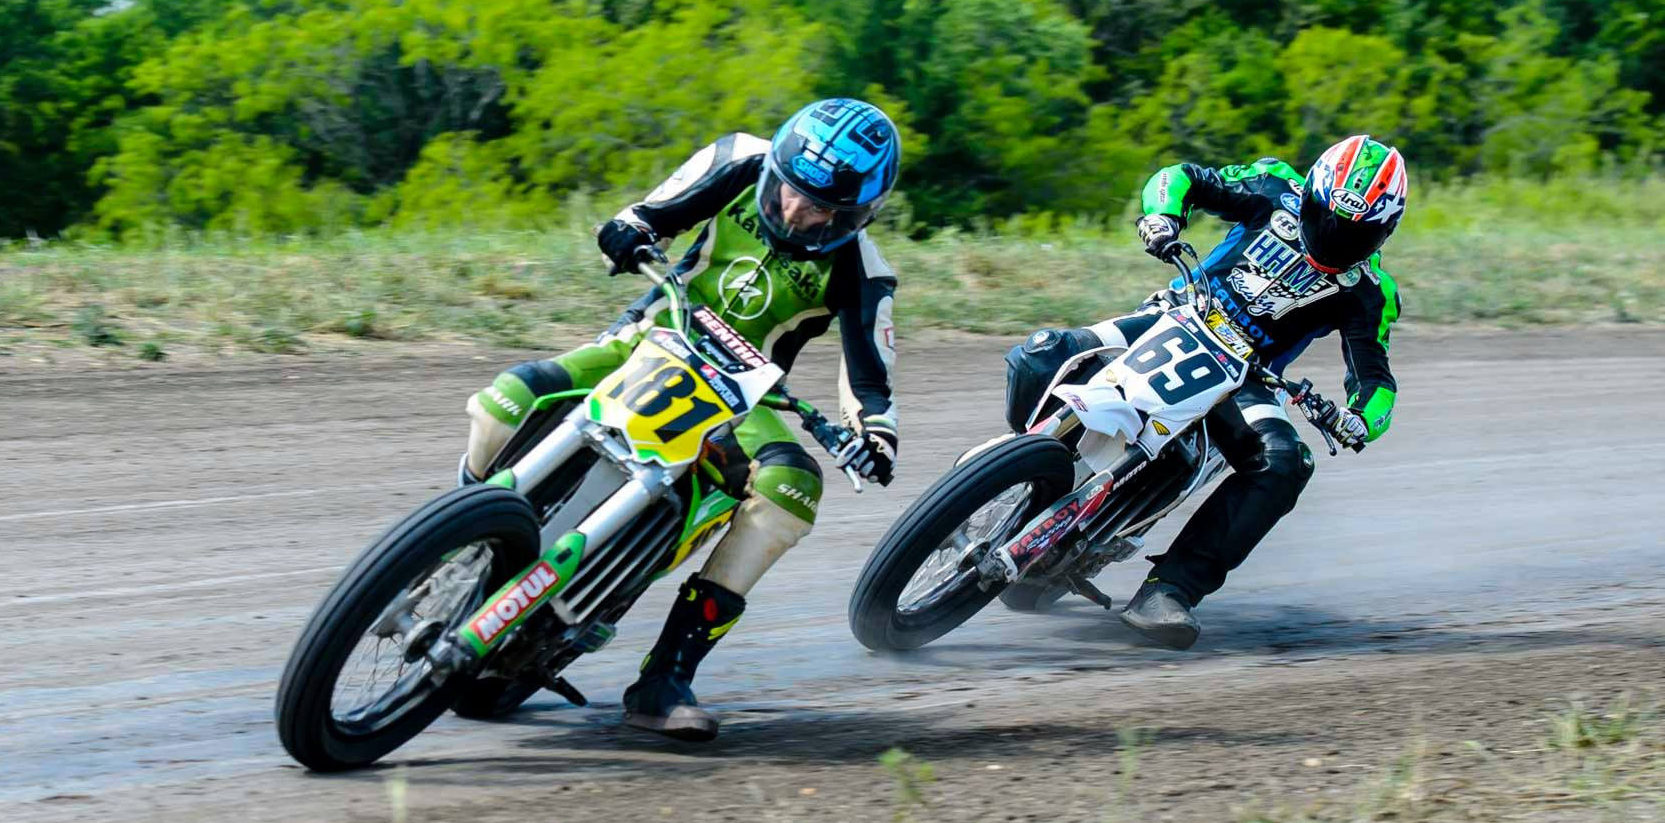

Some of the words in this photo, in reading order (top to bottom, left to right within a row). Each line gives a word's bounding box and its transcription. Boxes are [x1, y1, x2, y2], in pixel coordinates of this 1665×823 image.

[1334, 191, 1366, 211] Arai
[1248, 233, 1323, 294] HHM
[607, 356, 722, 444] 181
[1123, 326, 1227, 405] 69
[776, 483, 817, 512] SHAR
[475, 565, 559, 642] MOTUL
